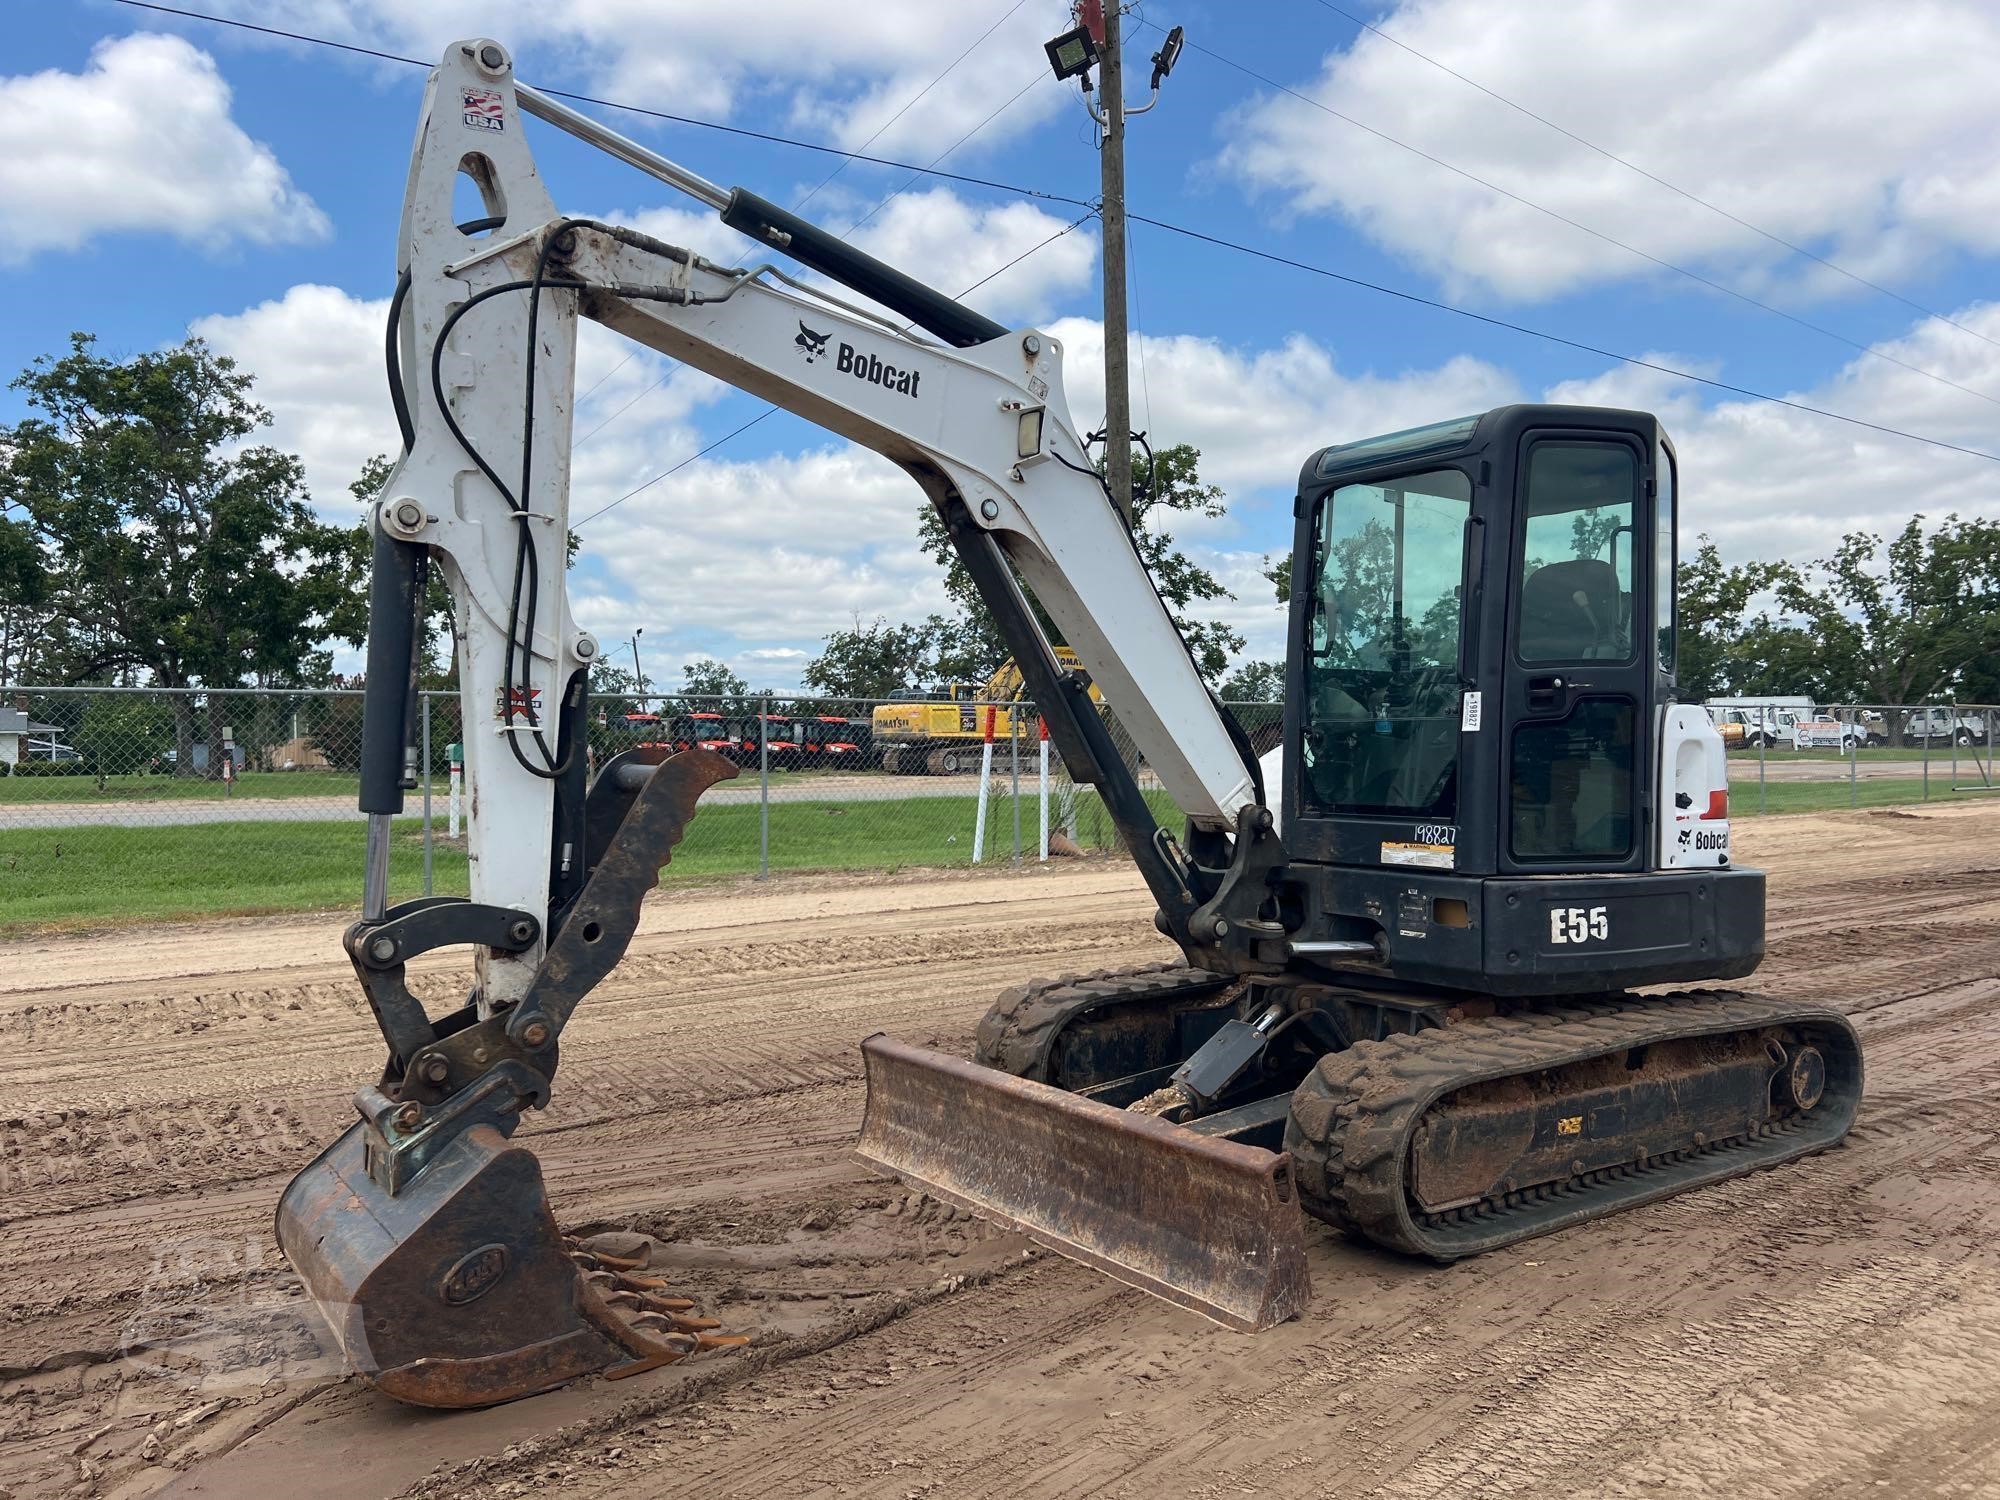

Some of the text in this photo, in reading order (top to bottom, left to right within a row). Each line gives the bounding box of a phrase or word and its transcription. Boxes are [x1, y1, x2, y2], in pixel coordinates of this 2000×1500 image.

[466, 115, 502, 130] USA
[837, 342, 920, 398] Bobcat
[1469, 700, 1477, 727] 198827
[1414, 825, 1456, 845] 198827
[1550, 907, 1608, 944] E55
